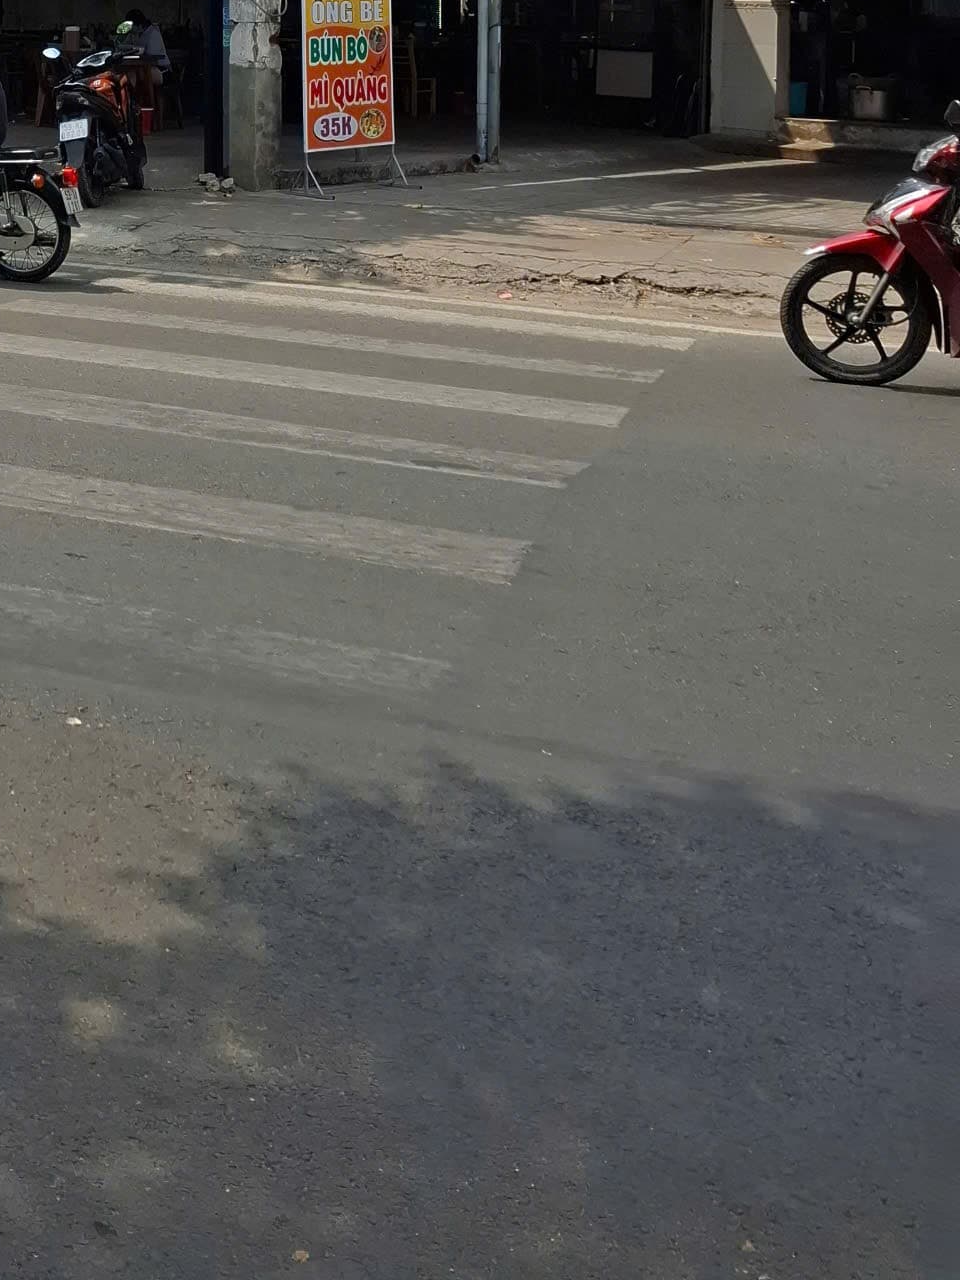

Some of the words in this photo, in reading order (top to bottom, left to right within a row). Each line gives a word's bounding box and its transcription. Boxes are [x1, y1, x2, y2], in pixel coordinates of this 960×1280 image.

[309, 29, 343, 65] BÚN
[346, 28, 368, 63] BÒ
[309, 72, 329, 108] MÌ
[332, 70, 387, 111] QUẢNG
[319, 116, 352, 138] 35K
